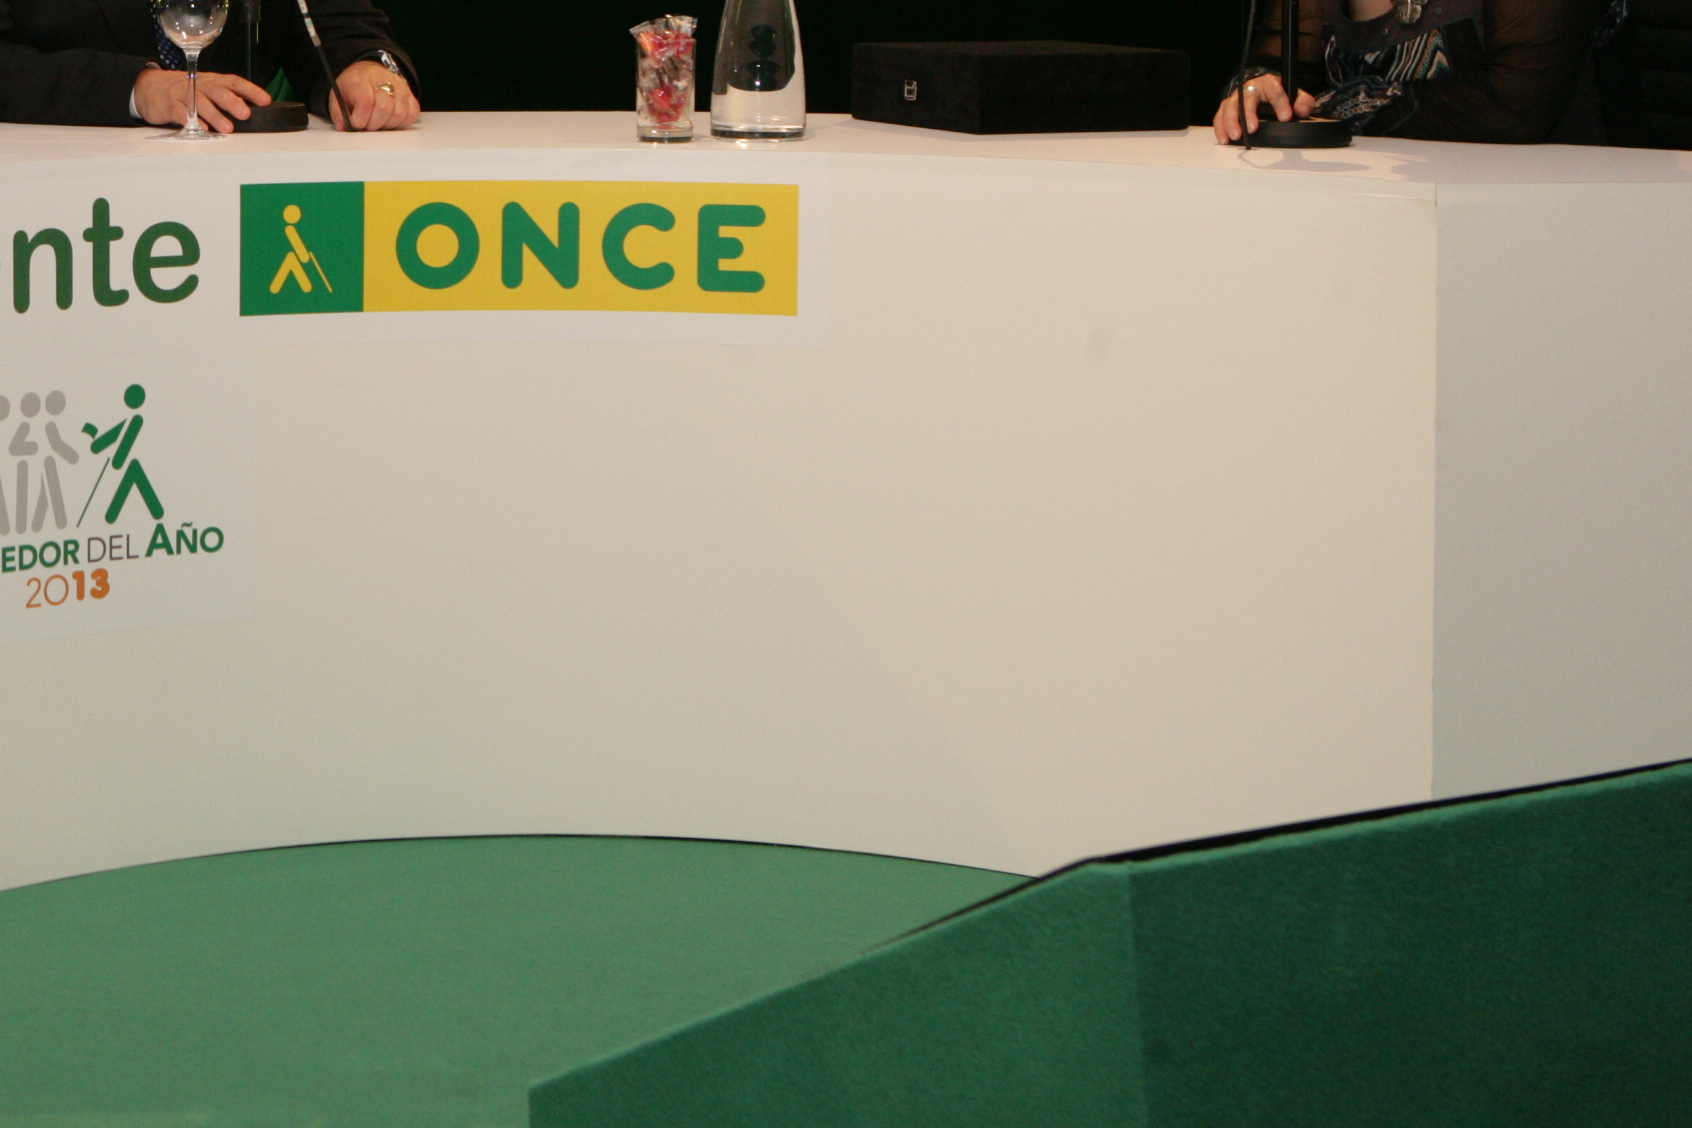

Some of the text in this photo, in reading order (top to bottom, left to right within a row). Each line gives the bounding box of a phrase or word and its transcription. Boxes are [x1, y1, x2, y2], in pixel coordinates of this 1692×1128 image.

[395, 201, 766, 293] ONCE
[87, 533, 140, 564] DEL
[144, 521, 225, 559] AÑO
[25, 567, 111, 609] 2013
